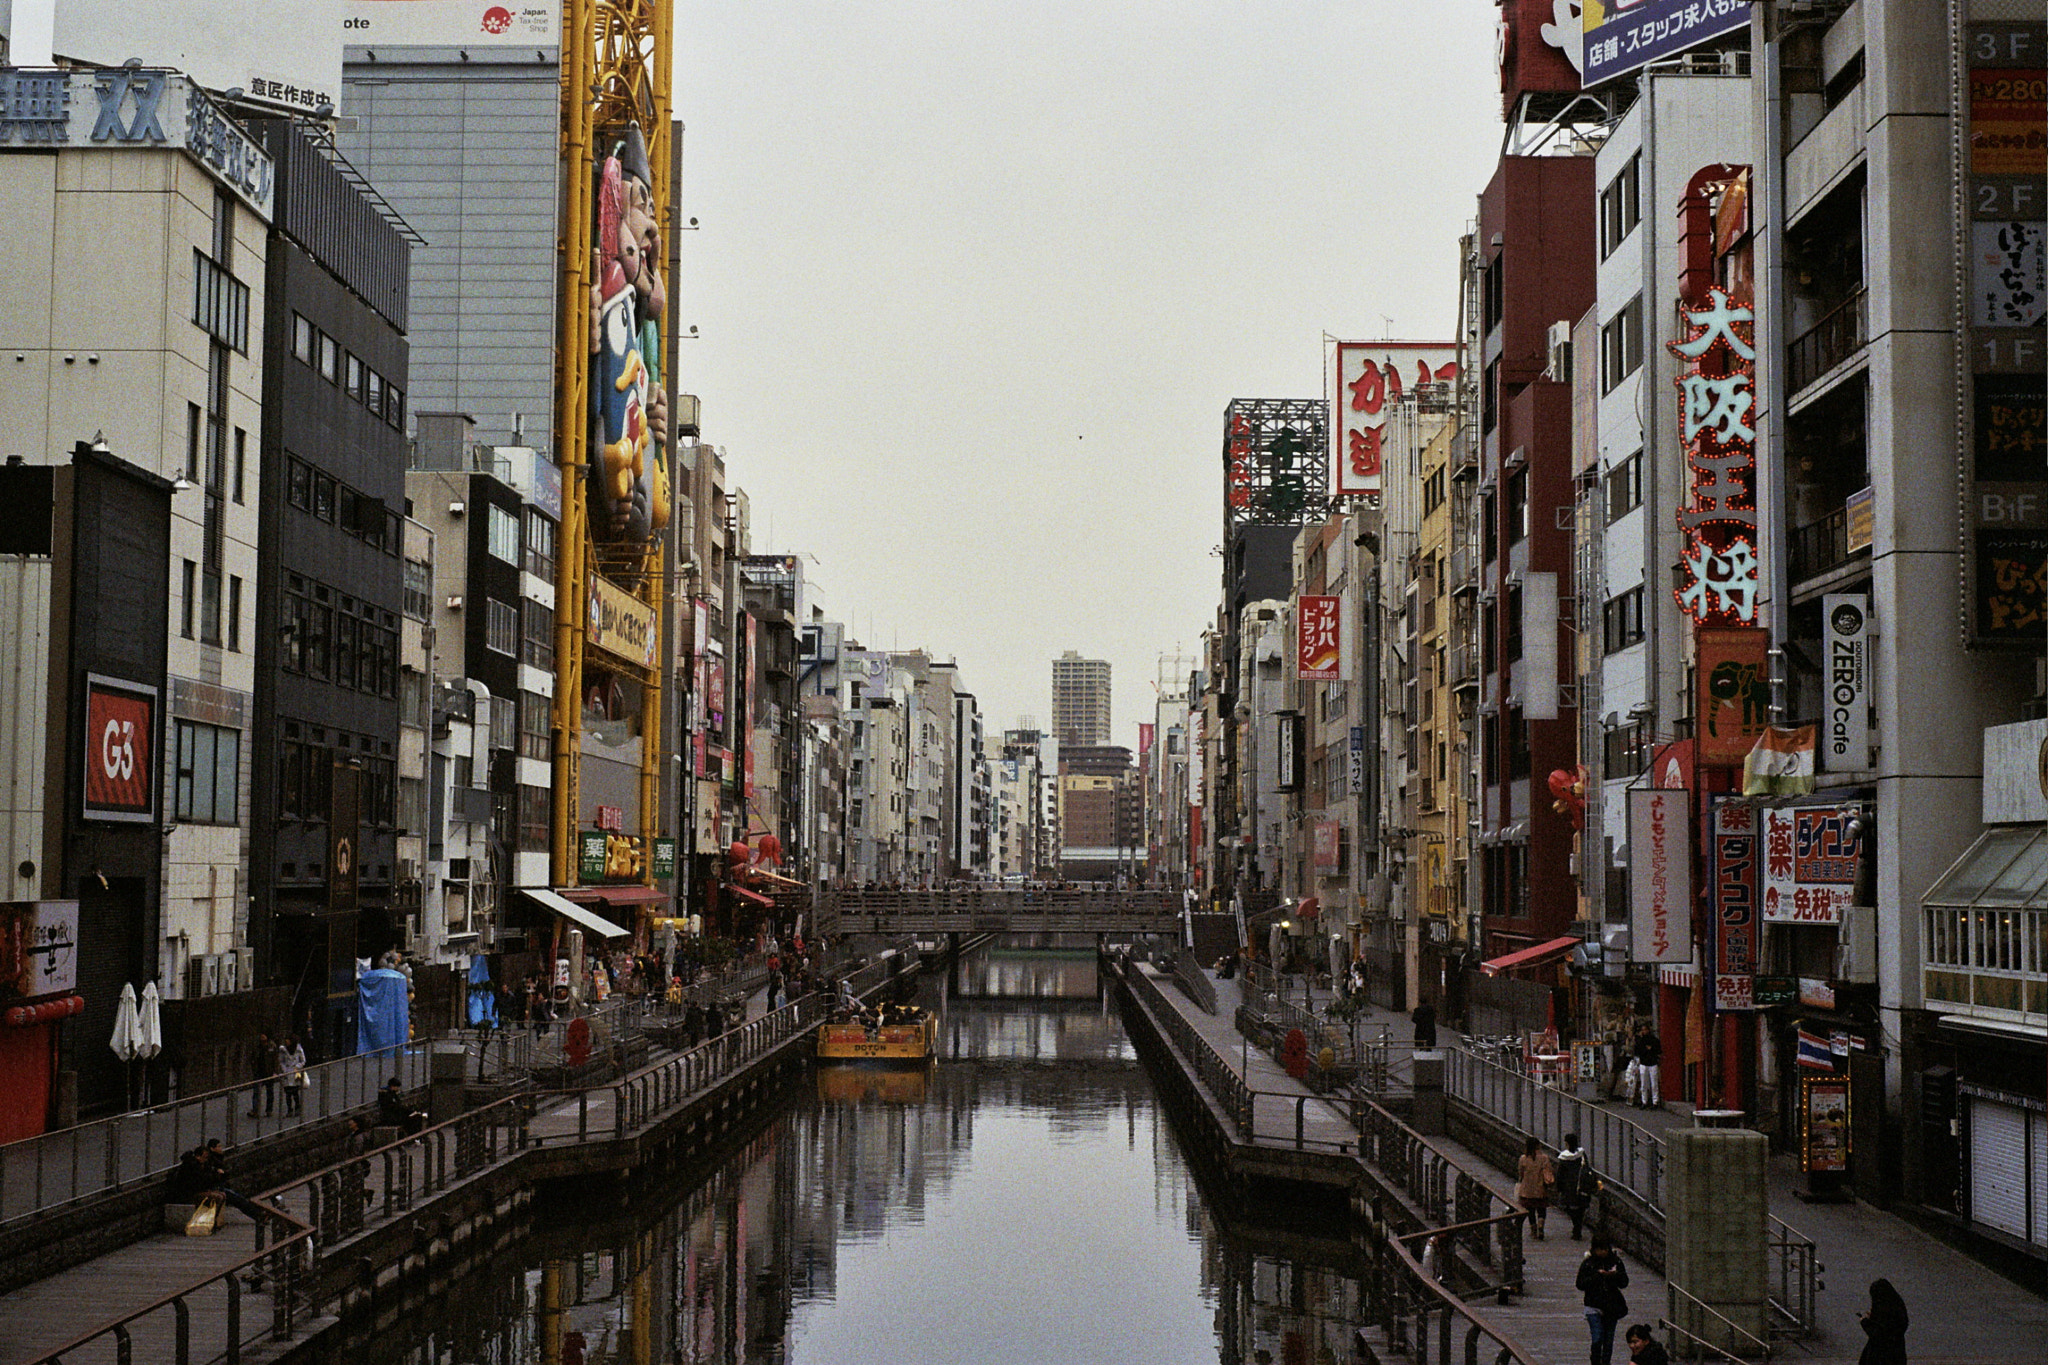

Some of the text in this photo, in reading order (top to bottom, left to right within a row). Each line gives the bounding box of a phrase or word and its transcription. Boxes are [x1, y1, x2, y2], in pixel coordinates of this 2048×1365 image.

[529, 25, 548, 33] Shop
[1589, 0, 1751, 67] 店舗・スタッフ求人も
[1668, 287, 1756, 625] 大阪王将
[1302, 608, 1318, 659] ドラッグ
[1318, 601, 1336, 647] ツルハ
[1988, 595, 2048, 631] ドン
[103, 719, 135, 781] G3
[1769, 811, 1792, 877] 薬
[1798, 815, 1858, 857] ダイコク
[1723, 838, 1750, 925] ダイコク
[1794, 888, 1832, 920] 免税
